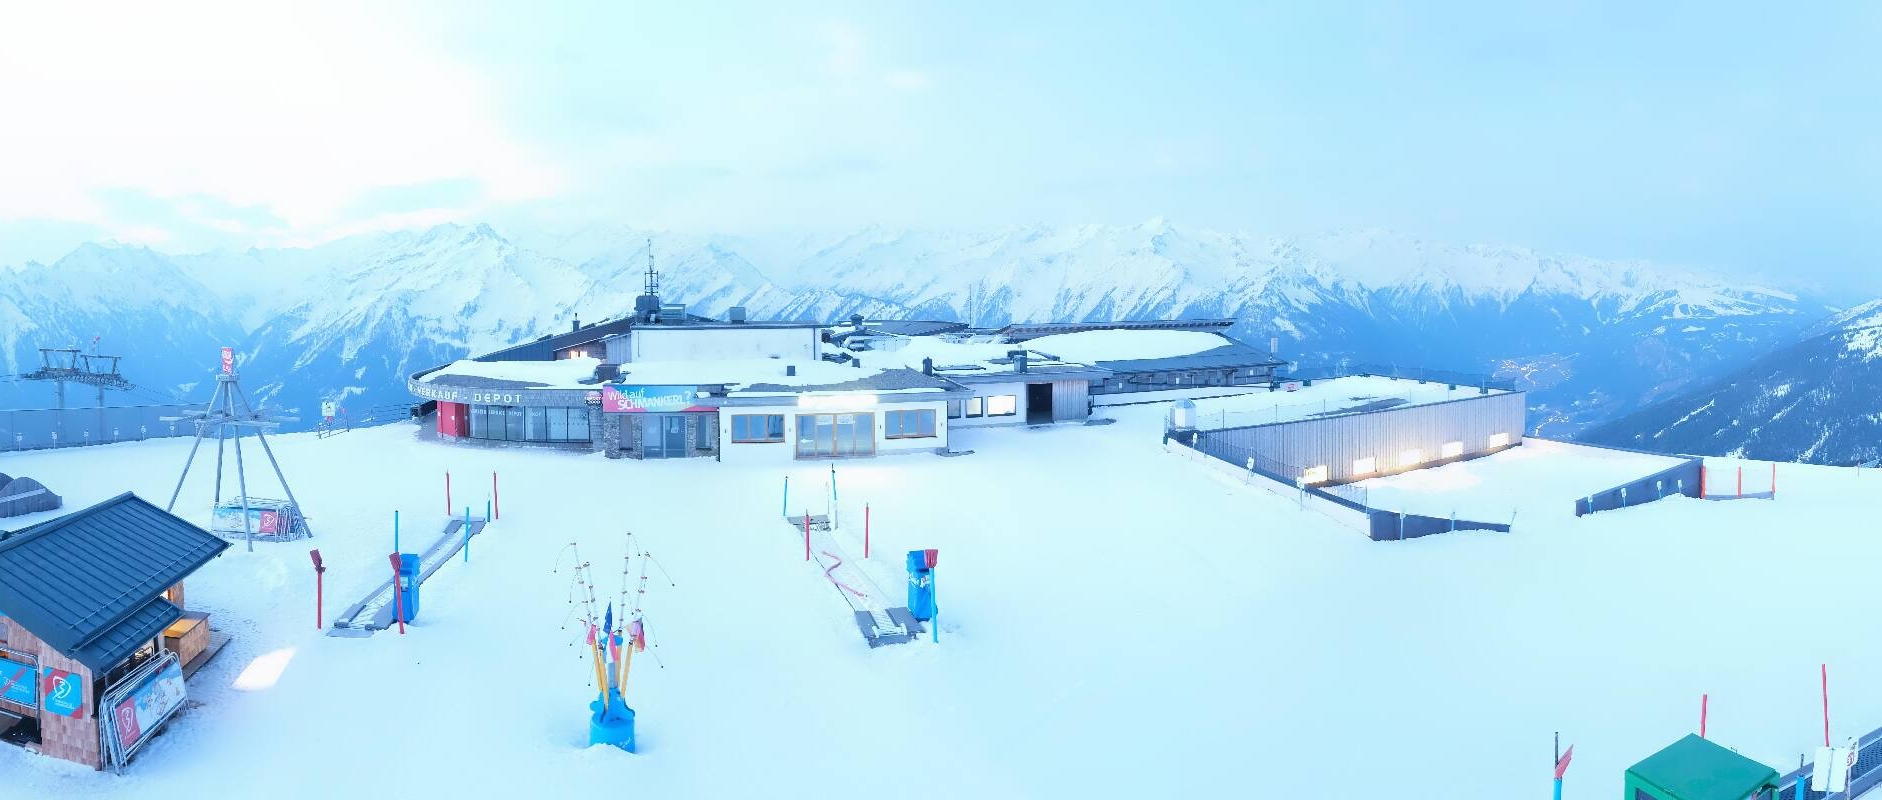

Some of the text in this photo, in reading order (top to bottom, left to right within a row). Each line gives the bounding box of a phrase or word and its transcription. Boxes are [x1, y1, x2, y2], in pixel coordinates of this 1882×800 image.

[417, 387, 458, 400] VERKAUF
[474, 393, 522, 403] DEPOT
[608, 387, 645, 400] Wild auf
